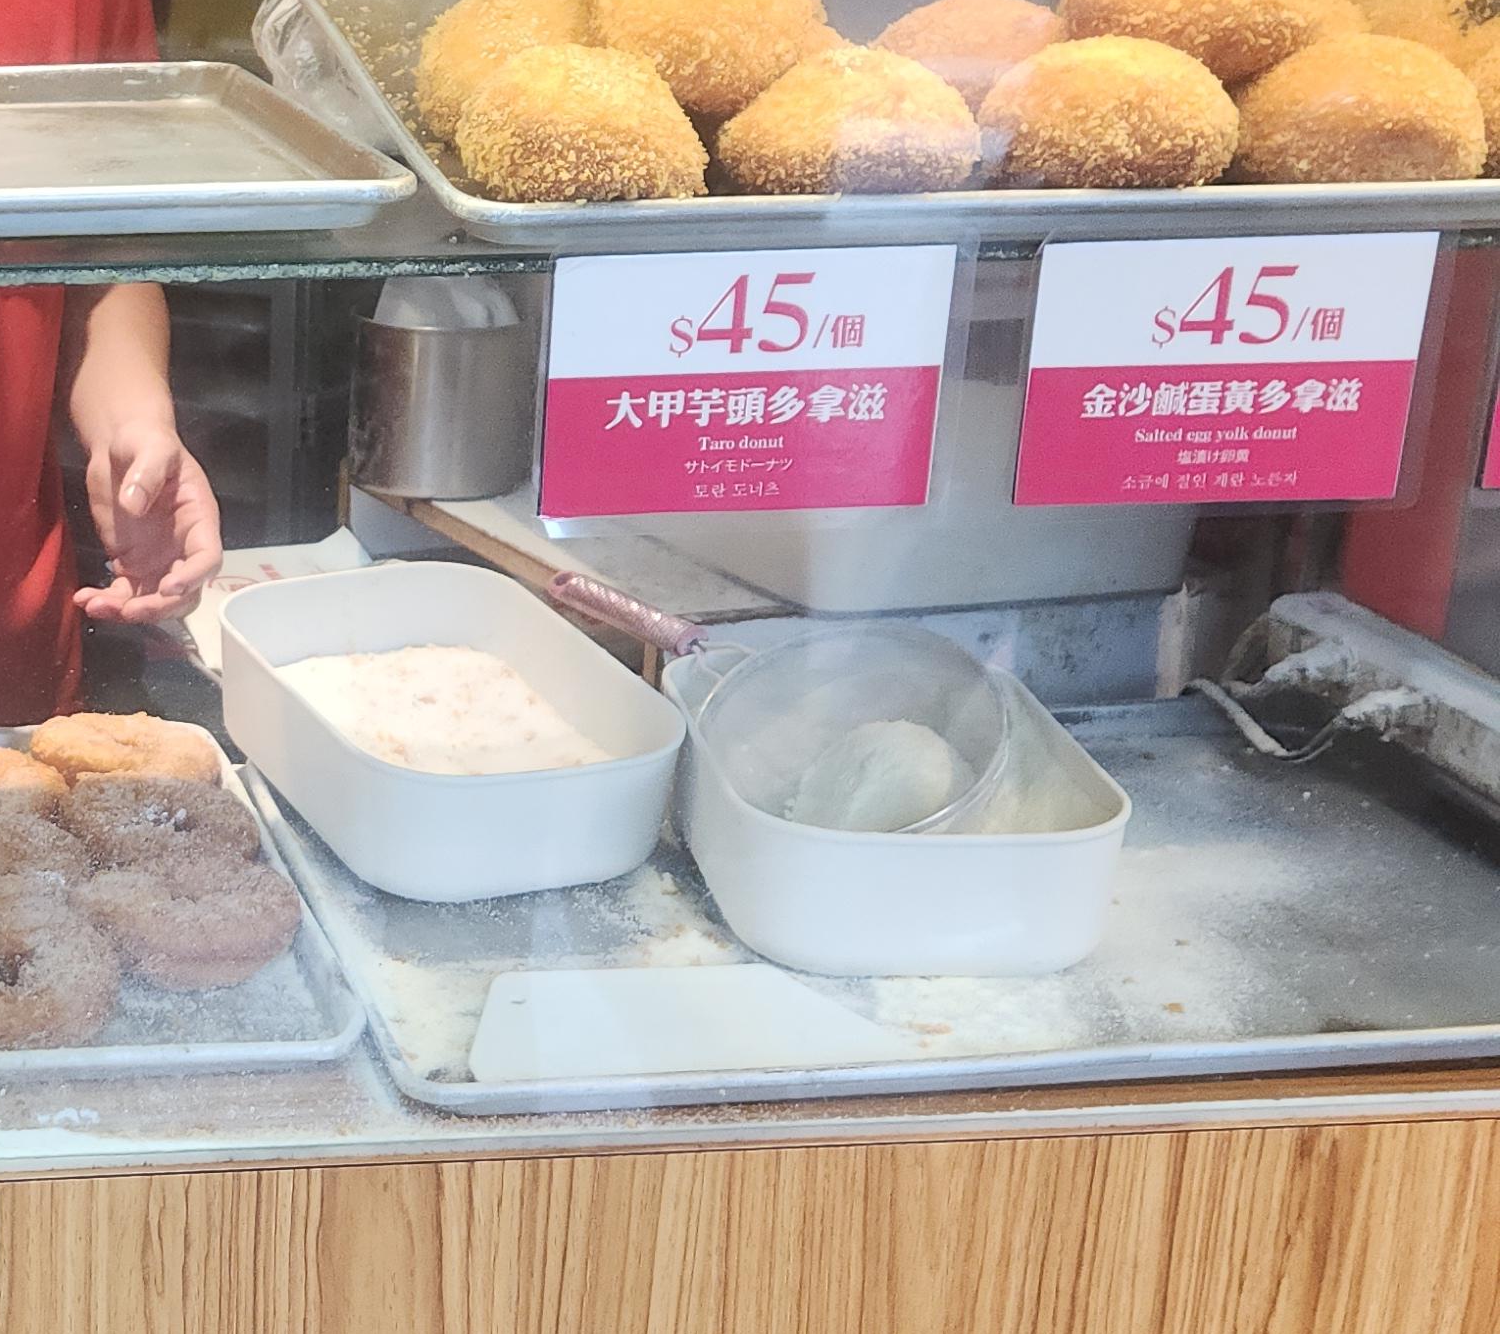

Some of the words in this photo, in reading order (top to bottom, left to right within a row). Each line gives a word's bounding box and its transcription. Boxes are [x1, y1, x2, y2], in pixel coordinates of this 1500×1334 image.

[669, 271, 865, 358] $45/個
[1151, 264, 1345, 349] $45/個
[605, 383, 888, 430] 大甲芋頭多拿滋
[1080, 378, 1363, 419] 金沙鹹蛋黃多拿滋
[698, 436, 735, 451] Taro
[738, 434, 784, 449] donut
[1134, 428, 1182, 443] Salted
[1186, 429, 1212, 443] egg
[1215, 426, 1249, 442] yolk
[1253, 426, 1297, 440] donut
[684, 457, 793, 475] サトイモドーナツ
[732, 482, 780, 498] 도너츠
